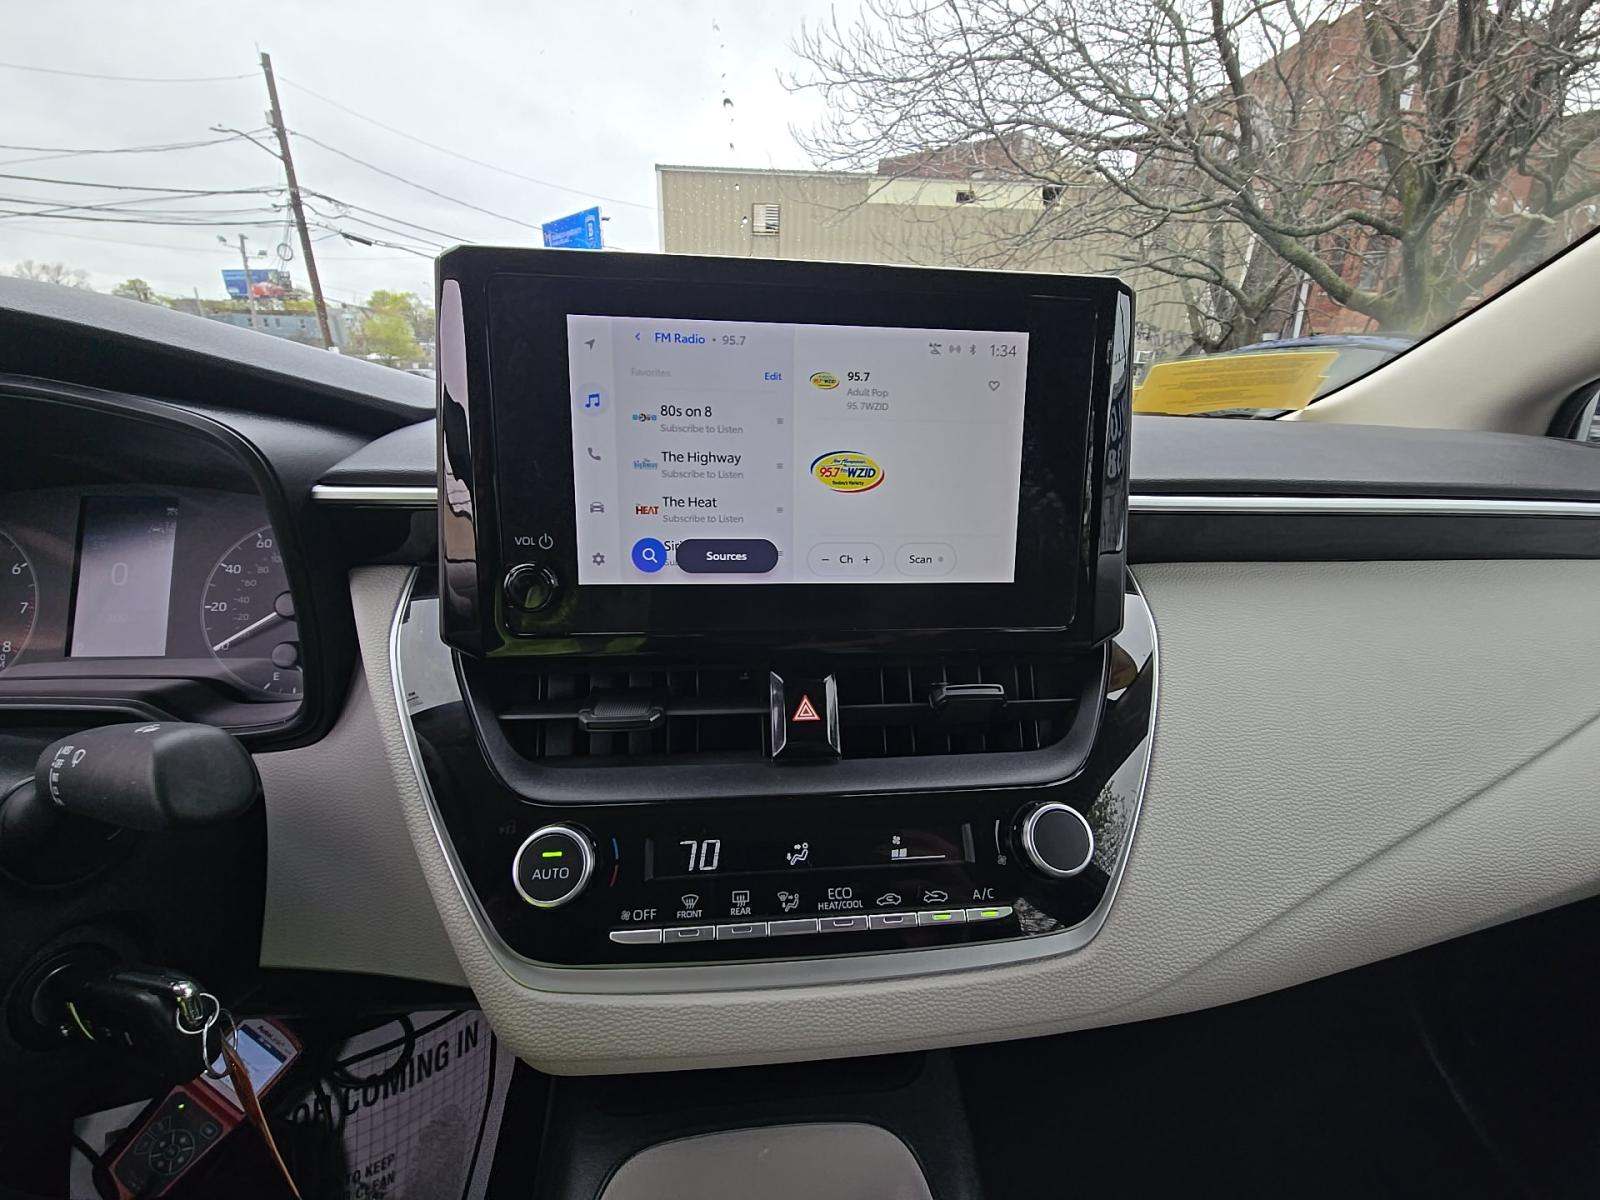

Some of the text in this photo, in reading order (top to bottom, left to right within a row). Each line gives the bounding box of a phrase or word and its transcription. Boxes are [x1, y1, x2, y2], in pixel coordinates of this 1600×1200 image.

[655, 332, 747, 346] FM Radio 95.7
[990, 344, 1017, 357] 1:34
[631, 367, 672, 378] Favorites
[764, 371, 783, 381] Edit
[847, 371, 871, 383] 95.7
[846, 388, 889, 399] Adult Pop
[660, 404, 683, 418] 80s
[685, 407, 702, 418] on
[704, 405, 713, 418] 8
[660, 423, 744, 434] Subscribe to Listen
[661, 451, 742, 466] The Highway
[661, 470, 744, 480] Subscribe to Listen
[847, 468, 877, 478] WZID
[662, 497, 717, 509] The Heat
[635, 505, 660, 515] HEAT
[663, 514, 744, 524] Subscribe to Listen
[256, 538, 273, 549] 60
[514, 536, 536, 546] VOL
[706, 551, 748, 562] Sources
[839, 555, 854, 565] Ch
[909, 555, 933, 565] Scan
[12, 564, 22, 575] 6
[111, 562, 129, 587] 0
[225, 564, 242, 575] 40
[20, 602, 29, 614] 7
[210, 602, 227, 612] 20
[2, 640, 12, 652] 8
[273, 672, 280, 681] E
[679, 839, 721, 871] 70
[531, 867, 570, 880] AUTO
[827, 887, 853, 899] ECO
[972, 888, 995, 899] A/C
[818, 900, 863, 911] HEAT/COOL
[633, 909, 657, 921] OFF
[676, 910, 702, 919] FRONT
[730, 907, 751, 916] REAR
[343, 1039, 450, 1117] COMING
[457, 1020, 479, 1058] IN
[365, 1153, 395, 1178] KEEP
